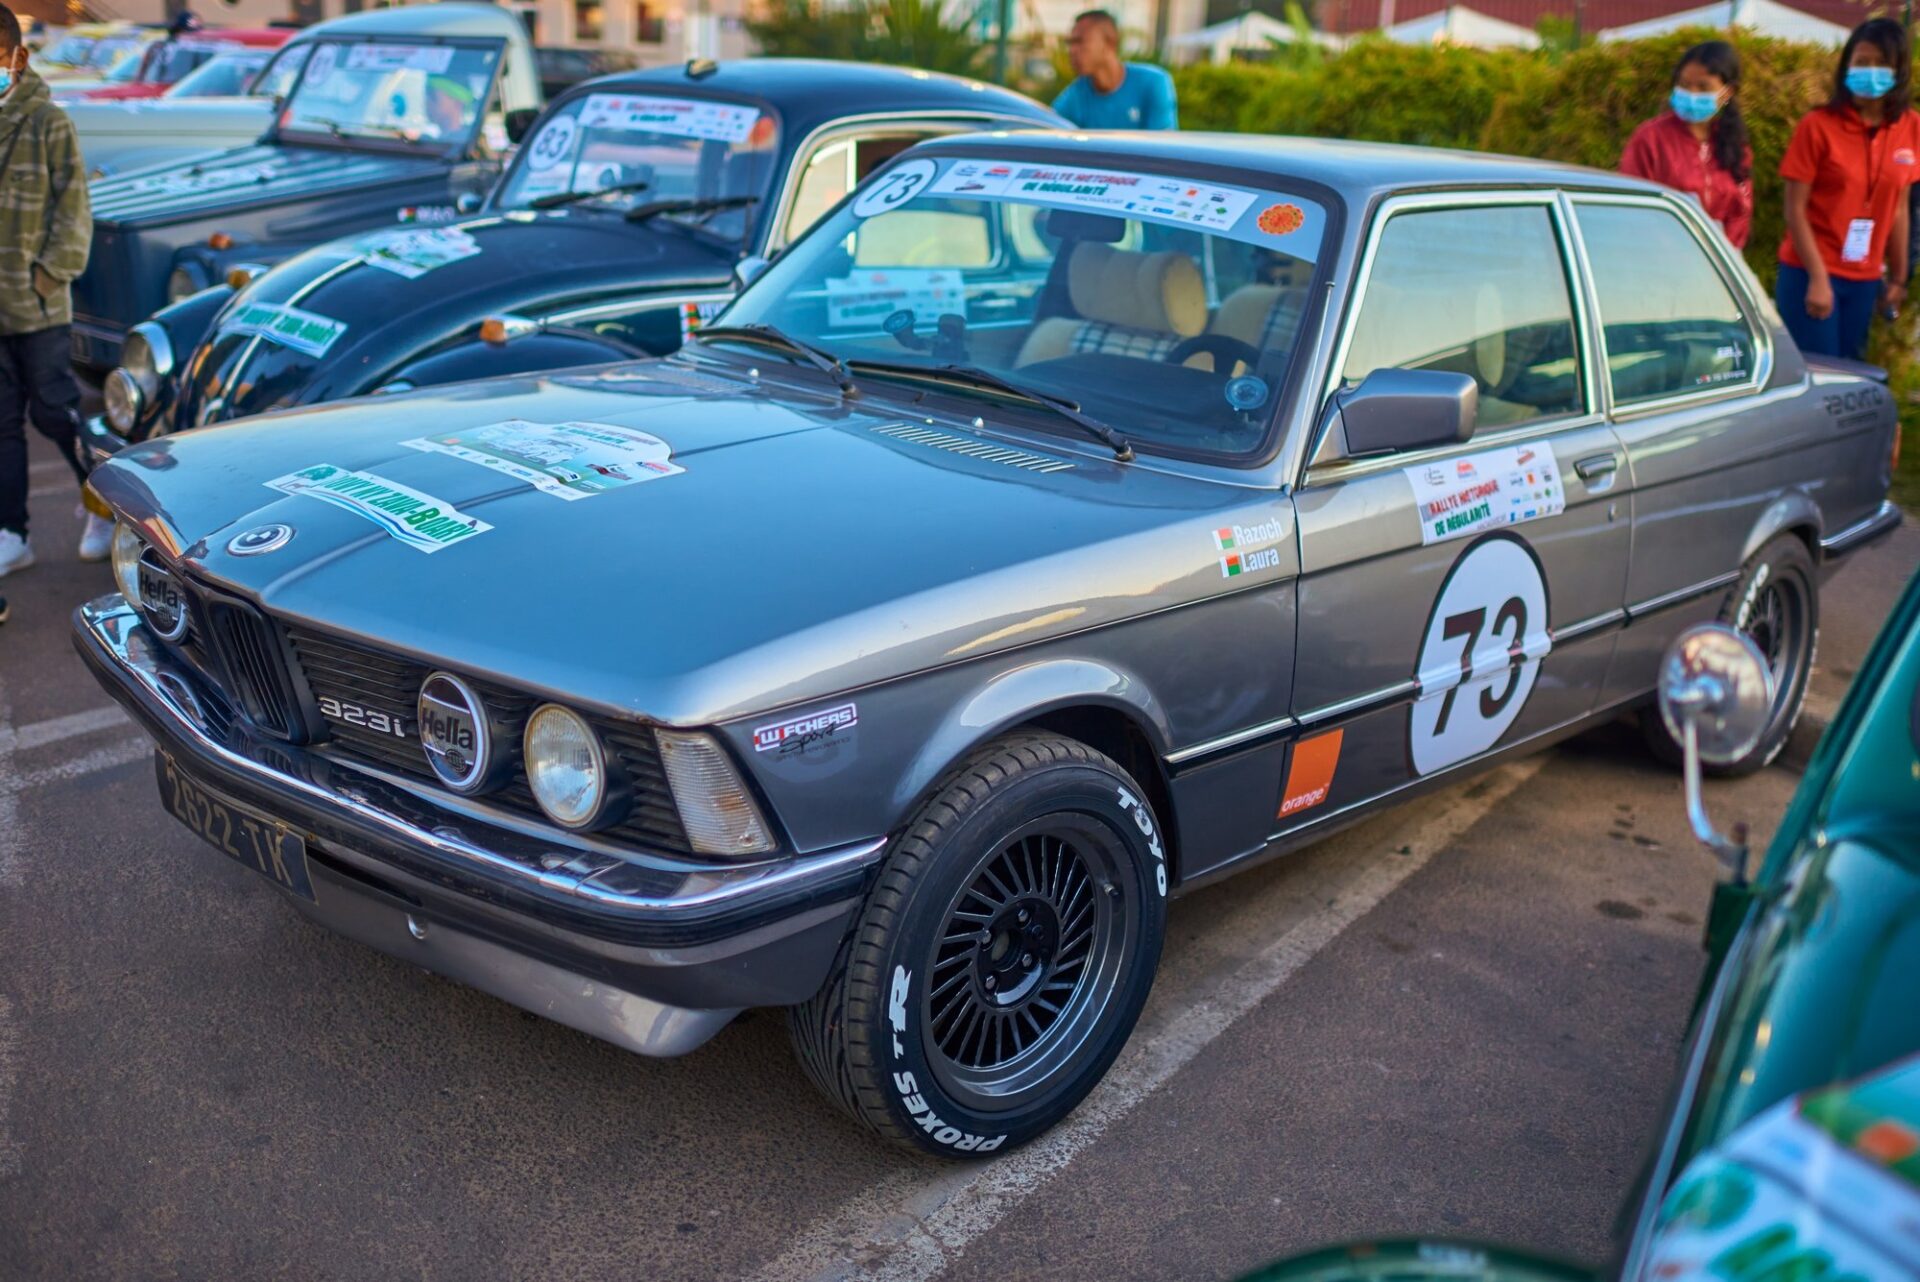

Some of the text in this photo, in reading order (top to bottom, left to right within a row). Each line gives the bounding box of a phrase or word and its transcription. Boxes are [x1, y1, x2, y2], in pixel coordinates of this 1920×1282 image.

[535, 127, 569, 159] 83
[865, 172, 924, 204] 73
[1429, 494, 1457, 517] RALLYE
[1232, 517, 1284, 546] Razoch
[1434, 520, 1446, 537] DE
[1240, 547, 1280, 573] Laura
[140, 570, 178, 609] Hella
[1432, 596, 1528, 738] 73
[319, 696, 406, 738] 323i
[421, 707, 474, 751] Hella
[166, 765, 241, 858] 2622
[1281, 788, 1325, 812] orange
[1117, 786, 1167, 897] TOYO
[892, 1070, 1008, 1152] PROXES
